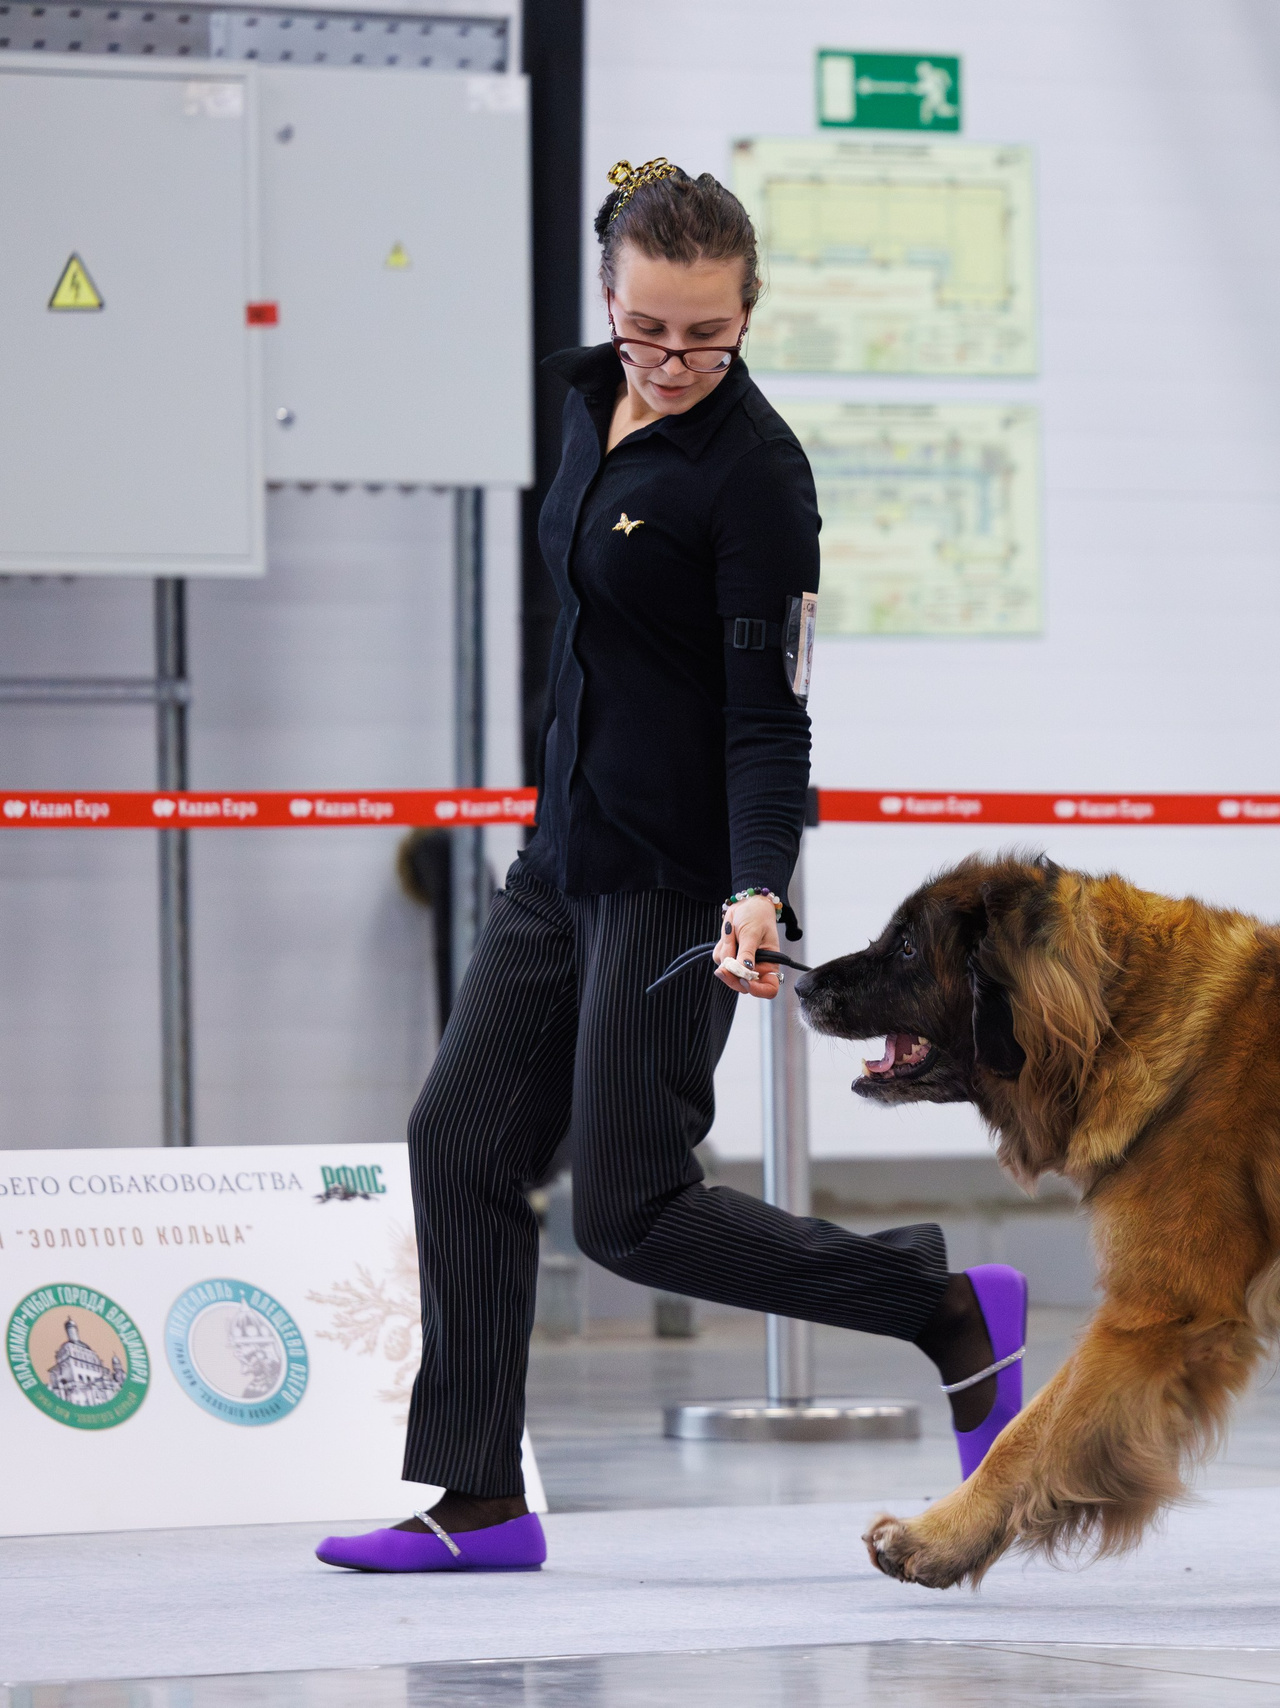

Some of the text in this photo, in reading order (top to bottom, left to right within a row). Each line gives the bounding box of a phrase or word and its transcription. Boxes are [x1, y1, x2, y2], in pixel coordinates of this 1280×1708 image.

[30, 798, 110, 822] Kazan Expo
[178, 798, 258, 820] Kazan Expo
[68, 1172, 304, 1195] СОБАКОВОДСТВА
[20, 1286, 148, 1385] КУБОК ГОРОДА ВЛАДИМИРА
[9, 1315, 38, 1390] ВЛАДИМИР
